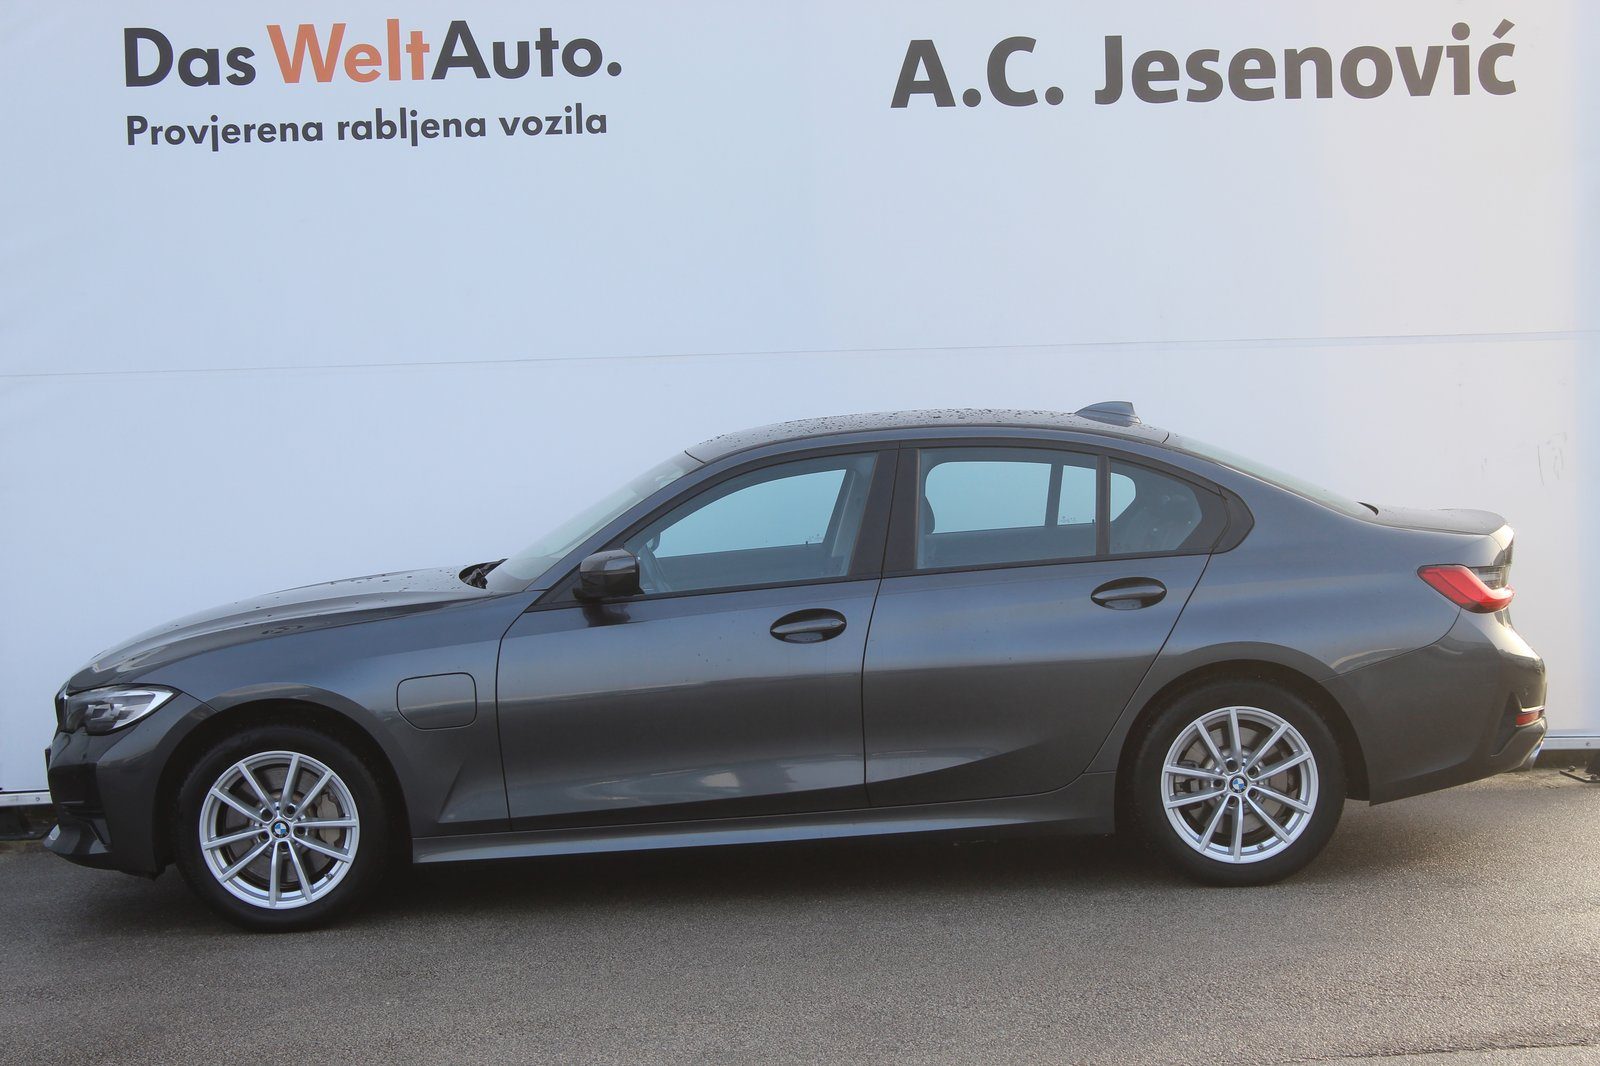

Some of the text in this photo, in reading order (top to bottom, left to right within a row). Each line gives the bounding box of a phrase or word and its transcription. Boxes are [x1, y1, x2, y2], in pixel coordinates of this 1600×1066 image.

[124, 27, 256, 87] Das
[891, 19, 1517, 108] A.C. Jesenović
[127, 103, 607, 152] Provjerena rabljena vozila
